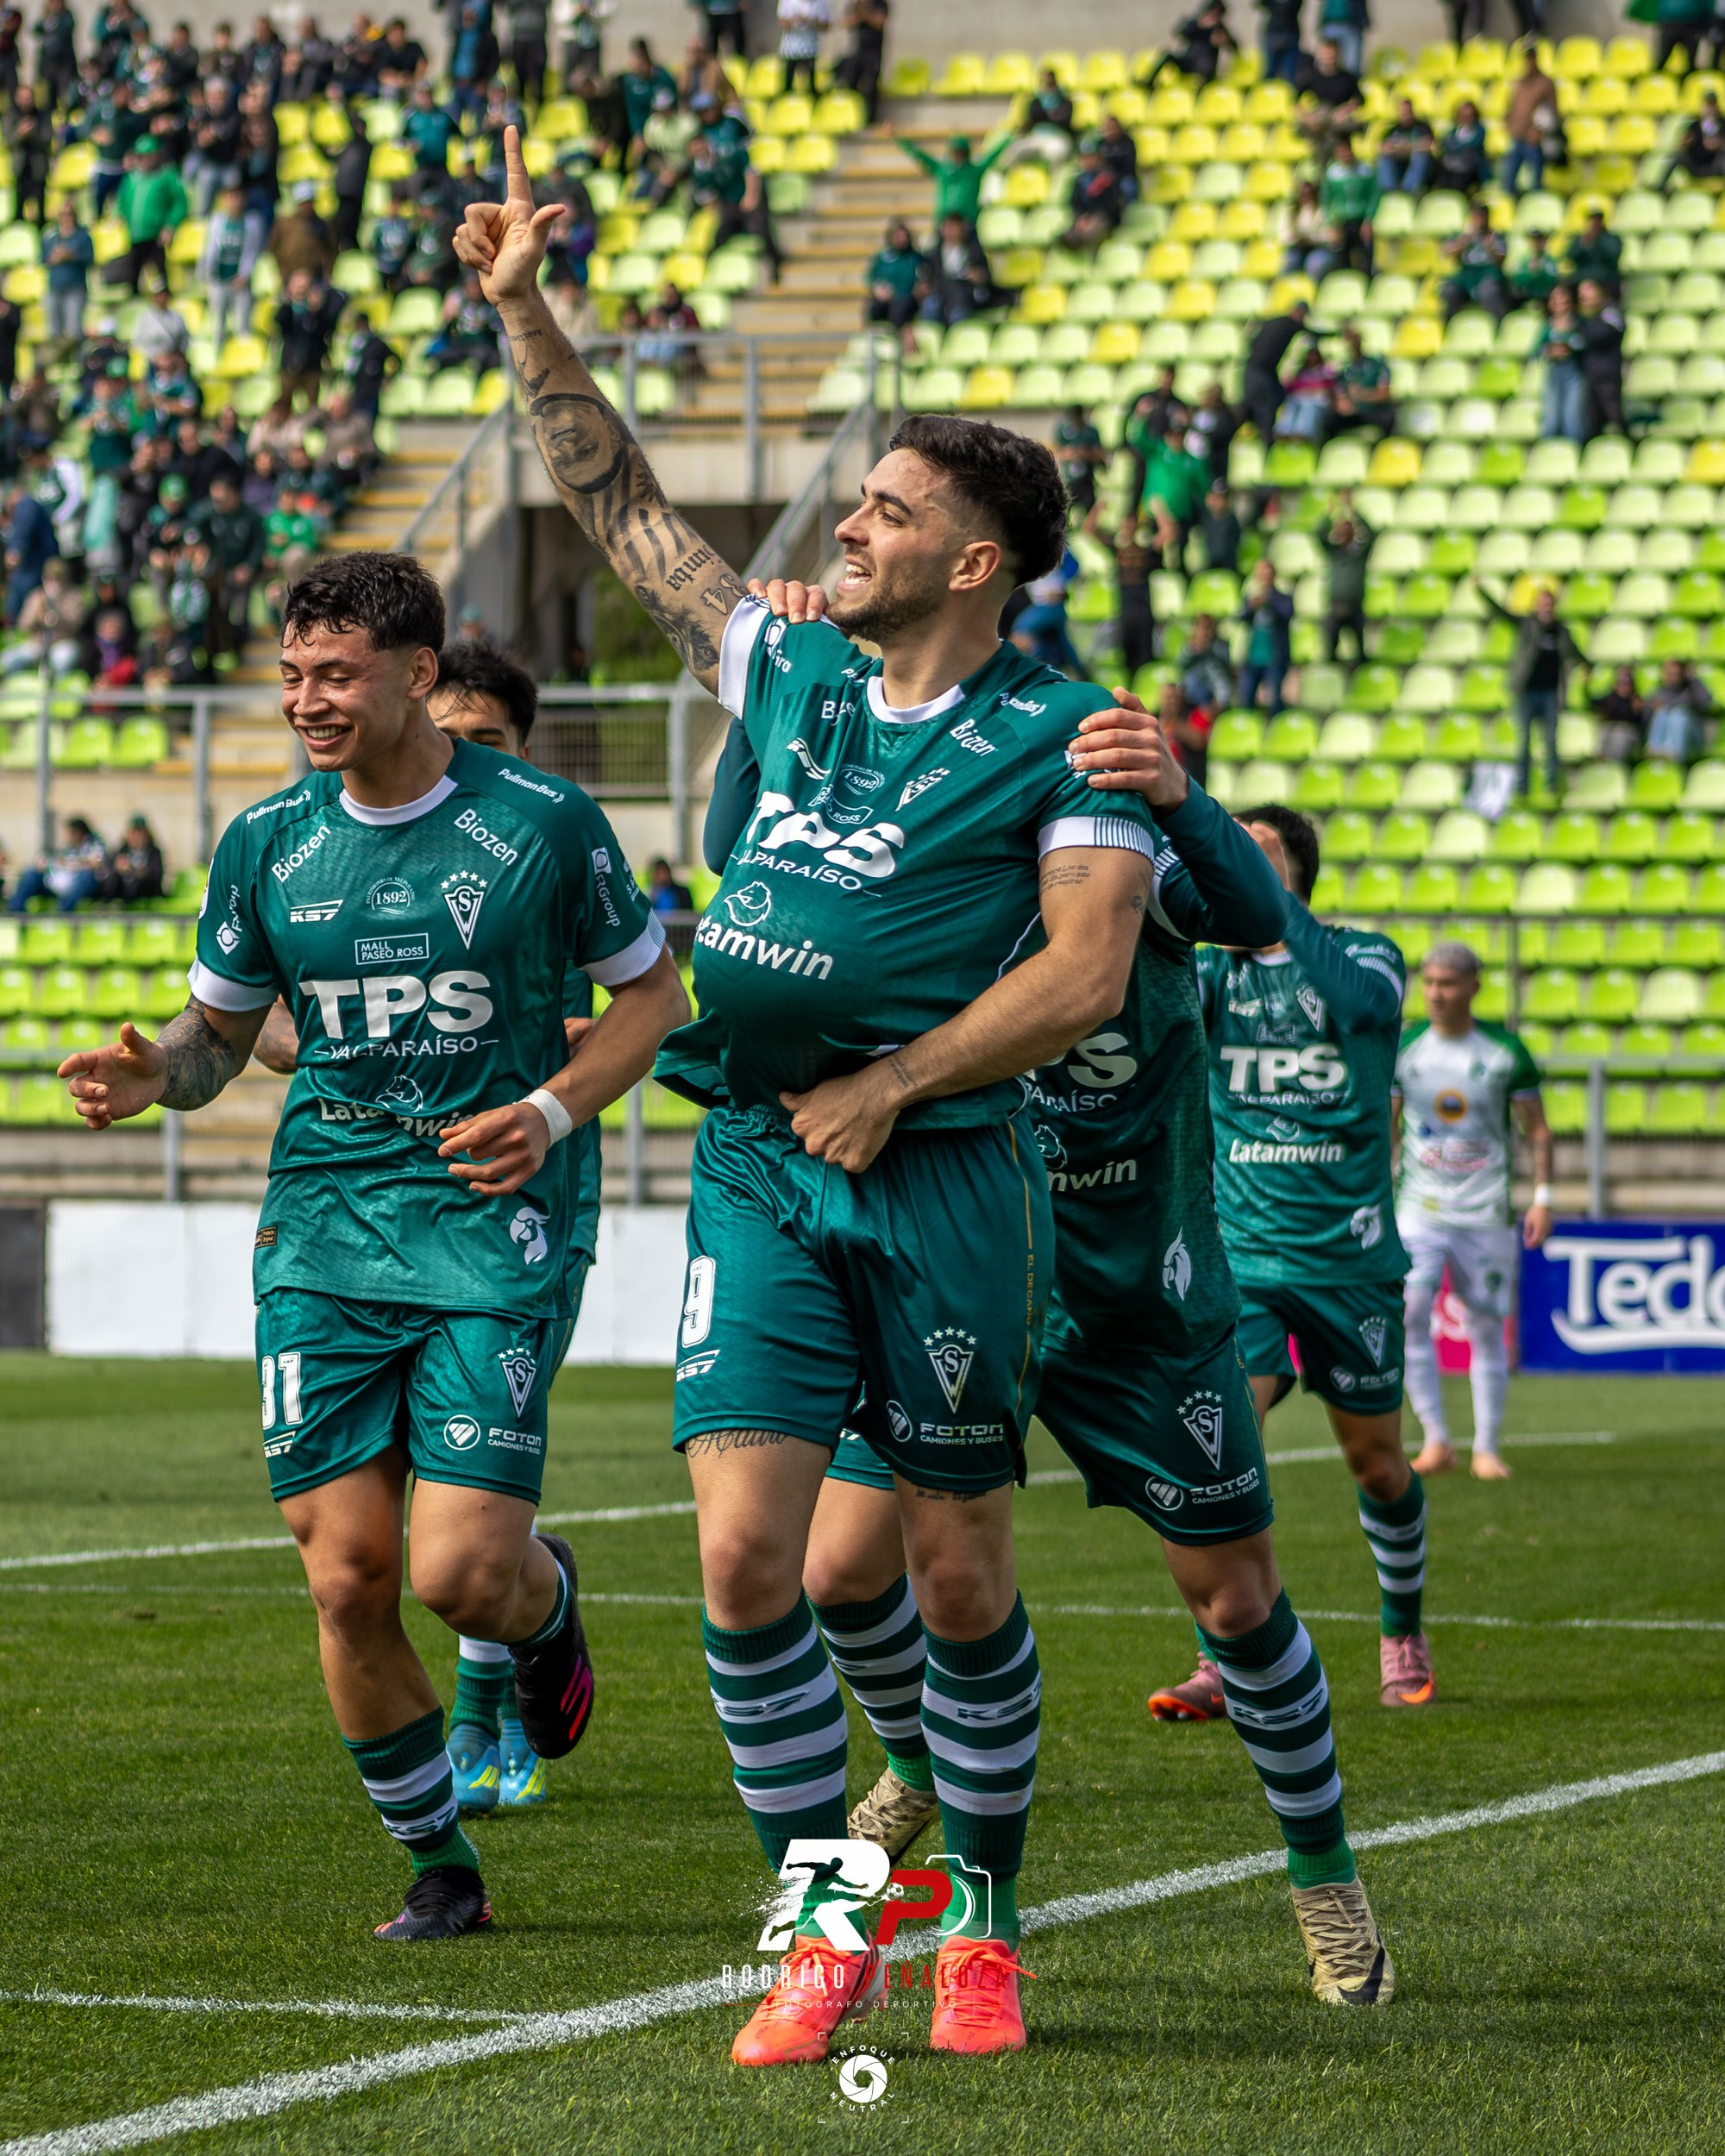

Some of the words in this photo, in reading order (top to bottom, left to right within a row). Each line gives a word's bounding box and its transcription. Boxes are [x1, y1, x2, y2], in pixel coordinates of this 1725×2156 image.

[844, 772, 876, 790] 1892
[832, 812, 861, 822] ROSS
[454, 808, 518, 866] Biozen
[746, 791, 905, 878] TPS
[271, 824, 331, 883] Biozen
[375, 890, 407, 905] 1892
[595, 874, 620, 927] RGroup
[290, 905, 342, 923] KS7
[361, 941, 390, 951] MALL
[361, 949, 394, 961] PASEO
[397, 946, 423, 957] ROSS
[298, 970, 492, 1040] TPS
[1220, 1044, 1346, 1093] TPS
[1228, 1138, 1343, 1163] Latamwin
[681, 1255, 716, 1349] 9
[488, 1427, 542, 1447] FOTON
[920, 1422, 1003, 1436] FOTON
[920, 1435, 966, 1445] CAMIONES
[975, 1435, 1003, 1445] BUSES
[487, 1438, 524, 1451] CAMIONES
[1189, 1467, 1258, 1495] FOTON
[1192, 1492, 1236, 1504] CAMIONES
[1242, 1478, 1260, 1494] BUSES
